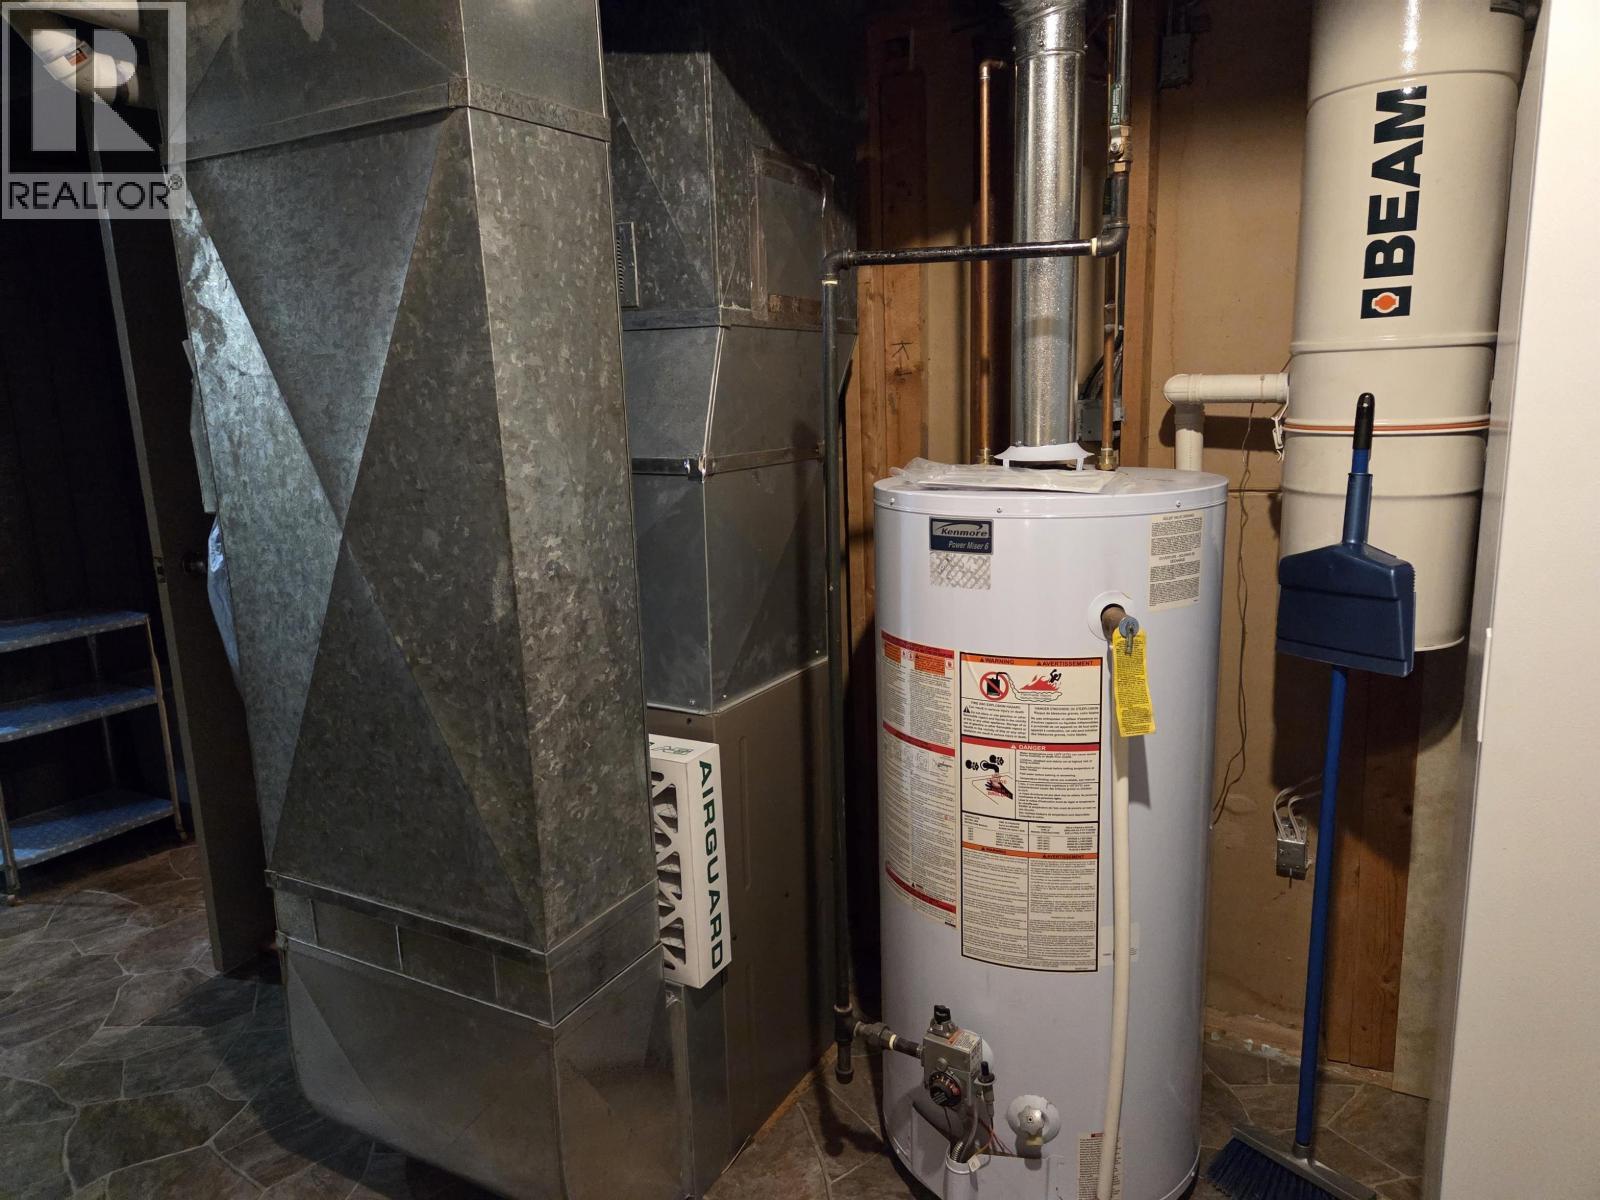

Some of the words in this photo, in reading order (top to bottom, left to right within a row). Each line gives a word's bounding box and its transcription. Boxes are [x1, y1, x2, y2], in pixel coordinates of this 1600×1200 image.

[1363, 85, 1427, 279] BEAM
[941, 528, 988, 537] Kenmore
[948, 540, 967, 549] Power
[967, 541, 983, 550] Miser
[699, 760, 724, 970] AIRGUARD
